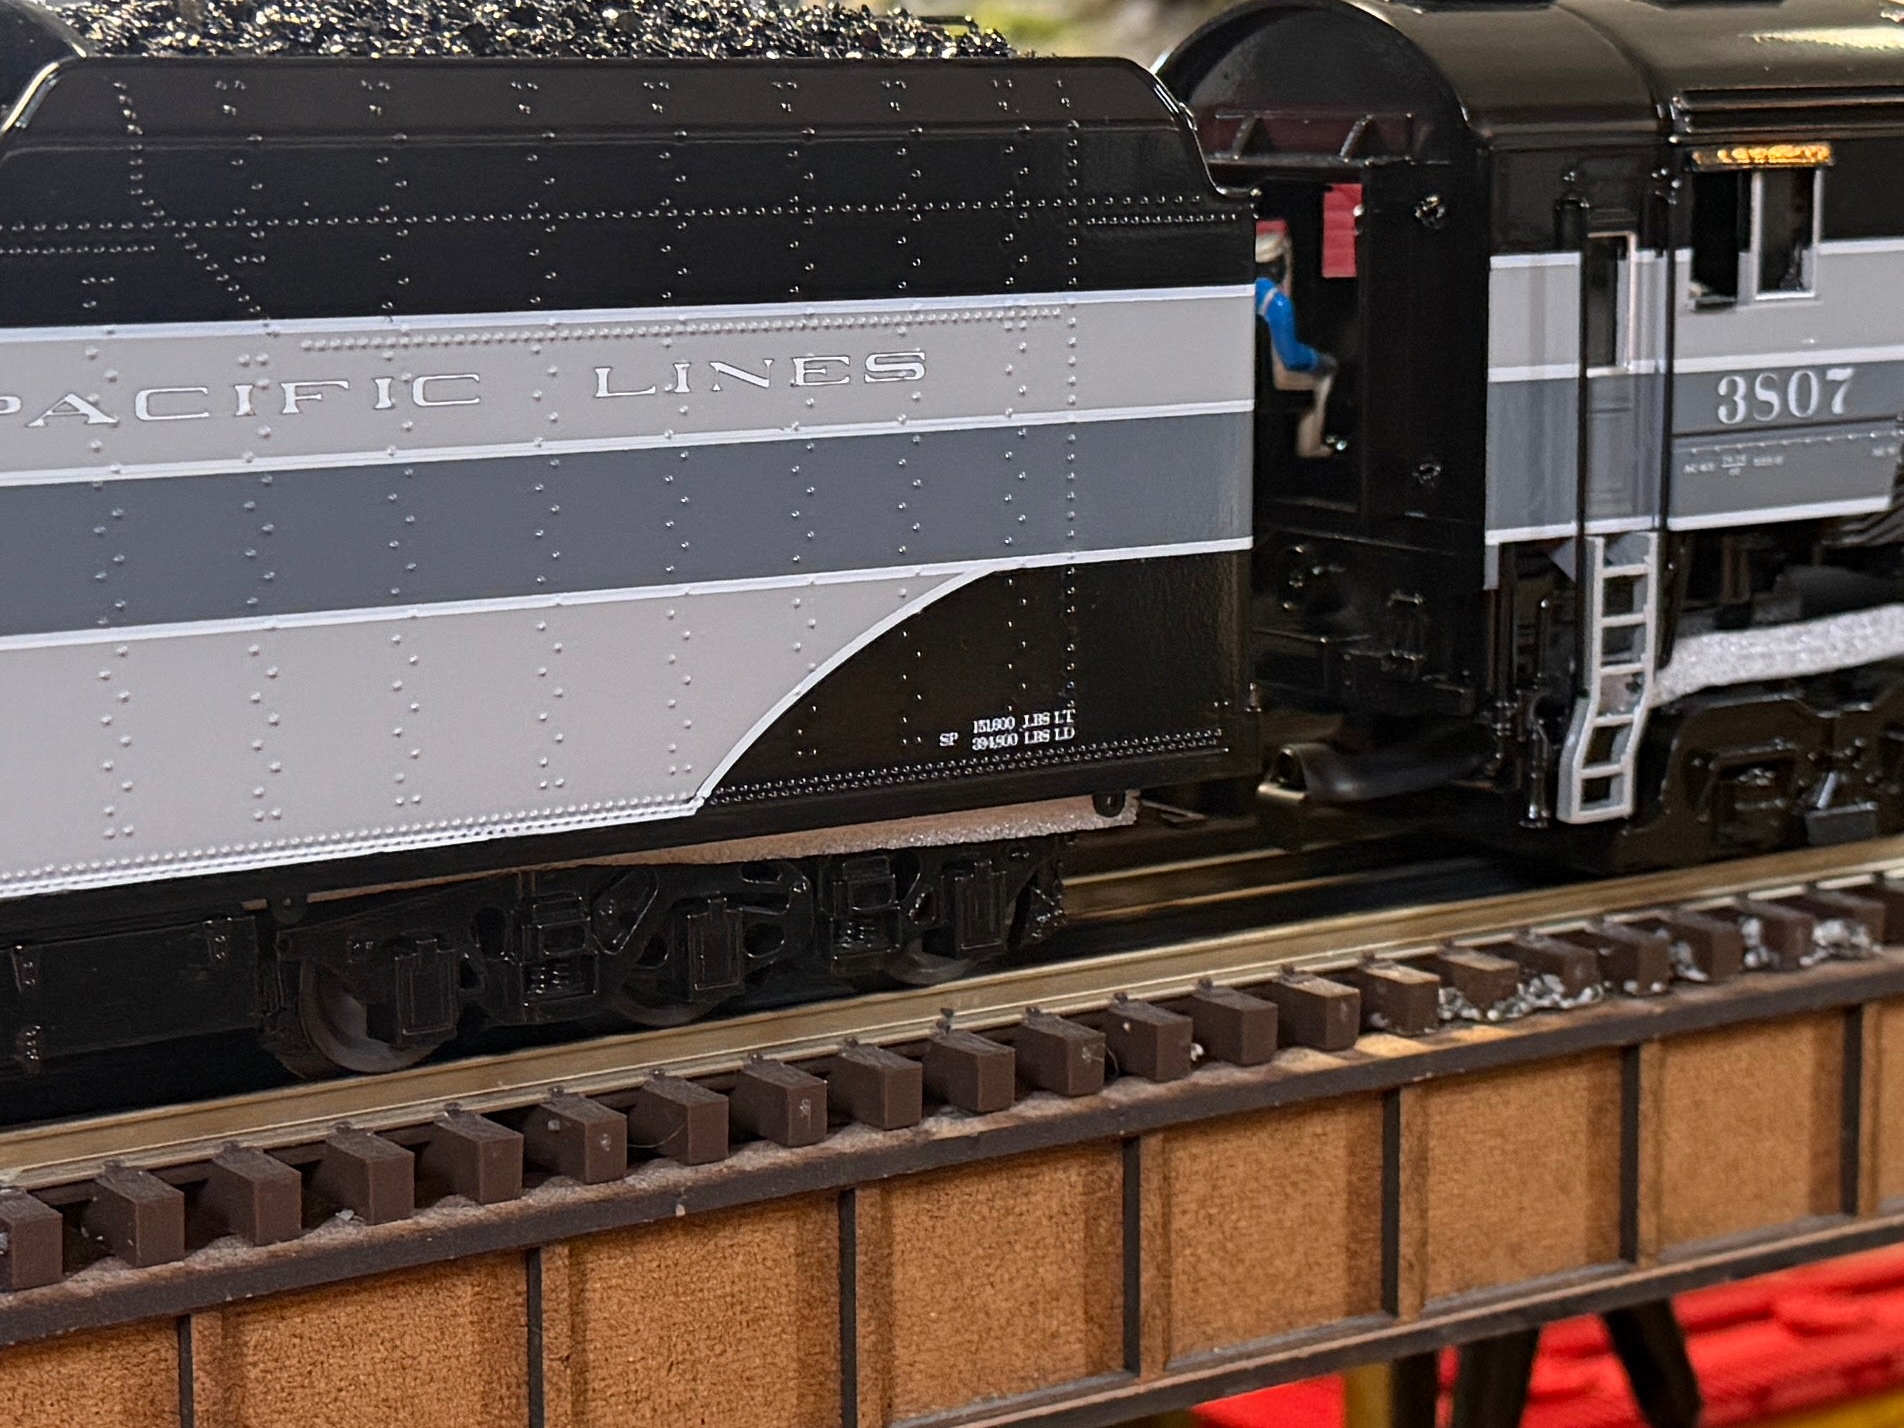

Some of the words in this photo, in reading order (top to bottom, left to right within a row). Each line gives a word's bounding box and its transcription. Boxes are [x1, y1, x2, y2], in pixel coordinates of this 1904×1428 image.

[593, 351, 926, 399] LINES
[1023, 712, 1050, 728] LBS
[1054, 709, 1075, 724] LT
[939, 732, 959, 746] SP
[1024, 729, 1050, 744] LBS
